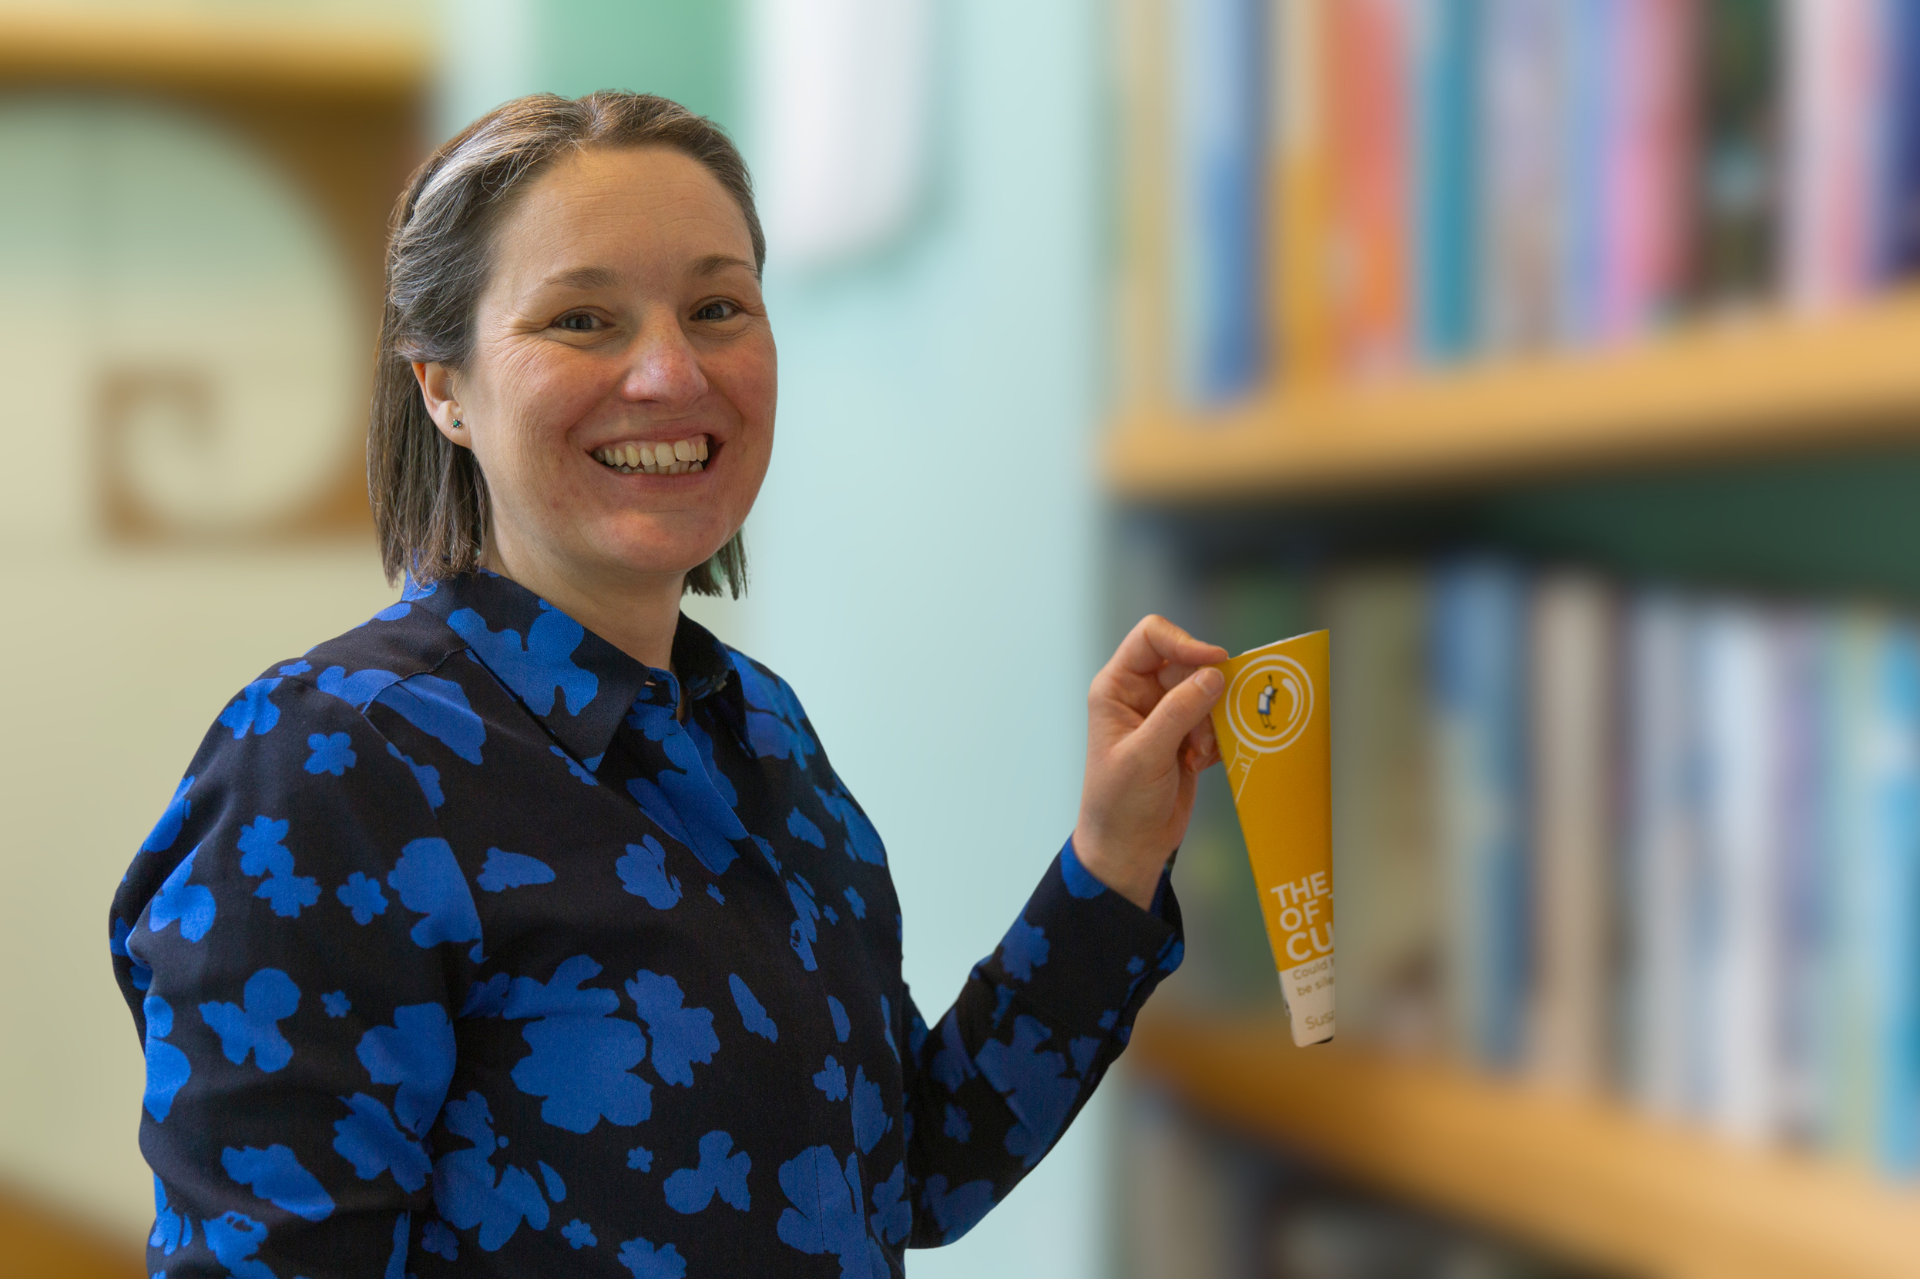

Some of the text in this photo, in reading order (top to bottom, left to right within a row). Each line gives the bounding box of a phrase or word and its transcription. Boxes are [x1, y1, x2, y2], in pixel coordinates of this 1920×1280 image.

[1270, 871, 1330, 909] THE
[1279, 899, 1320, 932] OF
[1286, 921, 1334, 961] CU
[1292, 960, 1329, 980] Could
[1296, 984, 1313, 996] be
